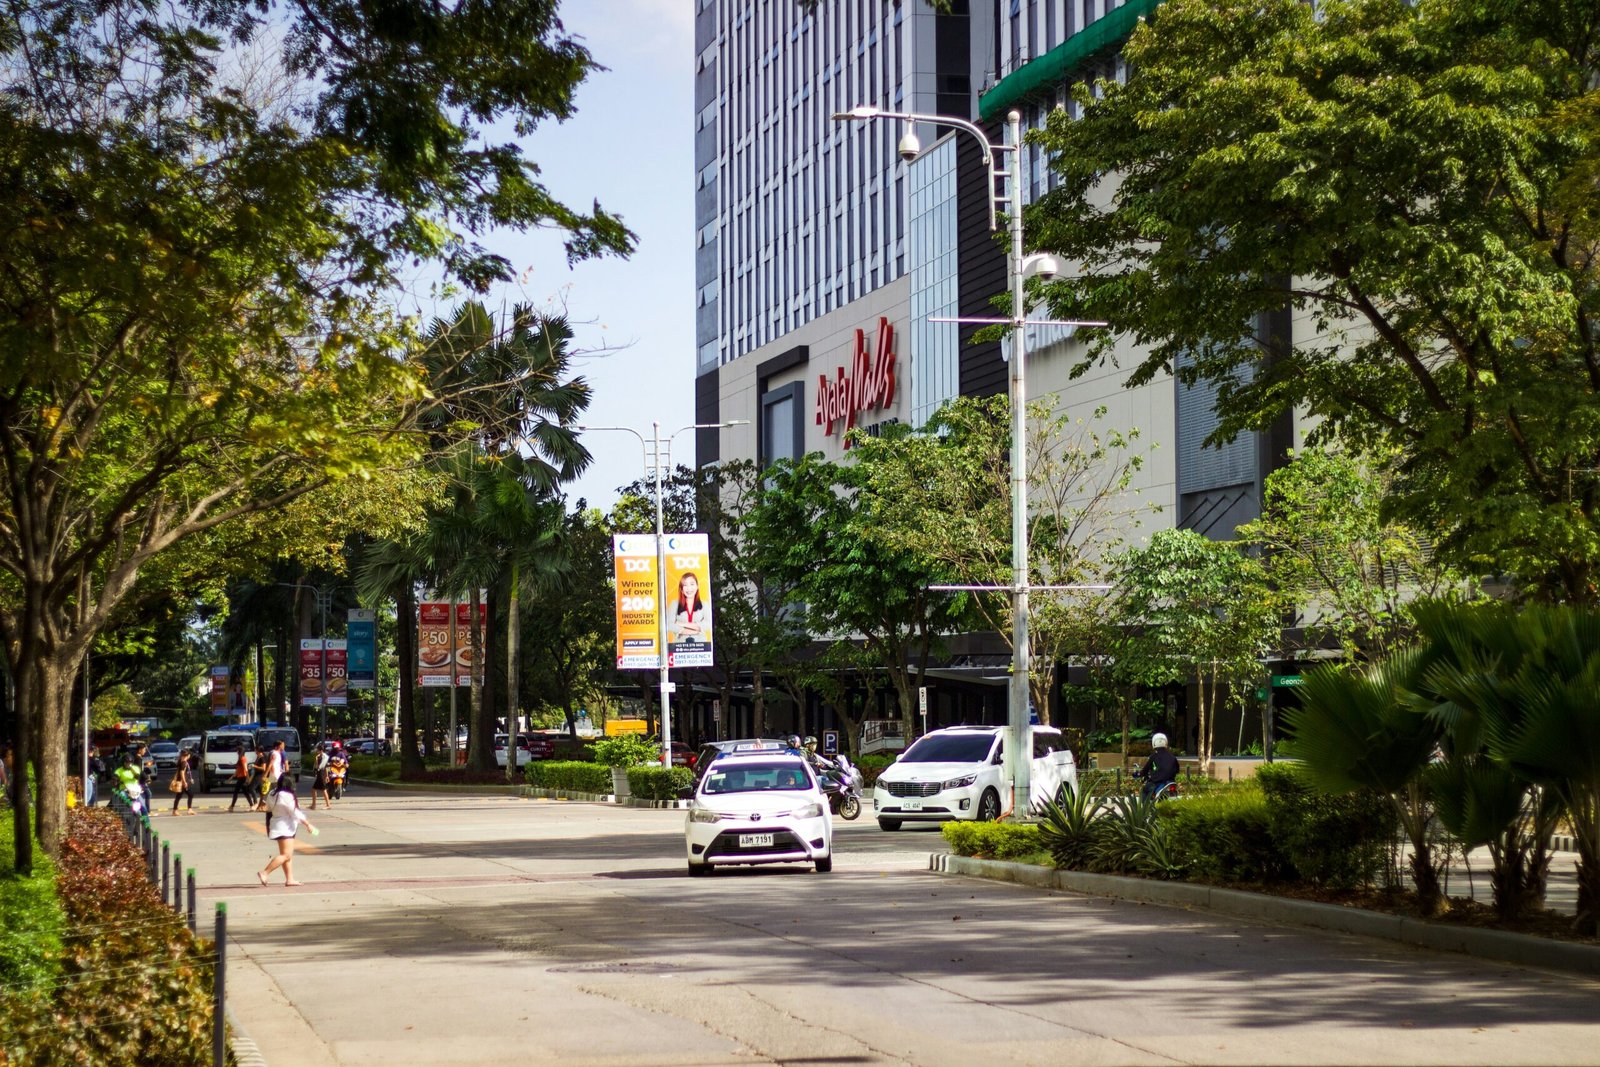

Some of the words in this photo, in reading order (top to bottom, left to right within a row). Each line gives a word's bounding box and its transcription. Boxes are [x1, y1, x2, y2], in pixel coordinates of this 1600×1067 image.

[815, 367, 849, 436] Ayala
[844, 317, 896, 449] Malls
[621, 596, 654, 611] 200
[826, 733, 835, 745] P
[756, 835, 771, 843] 7191
